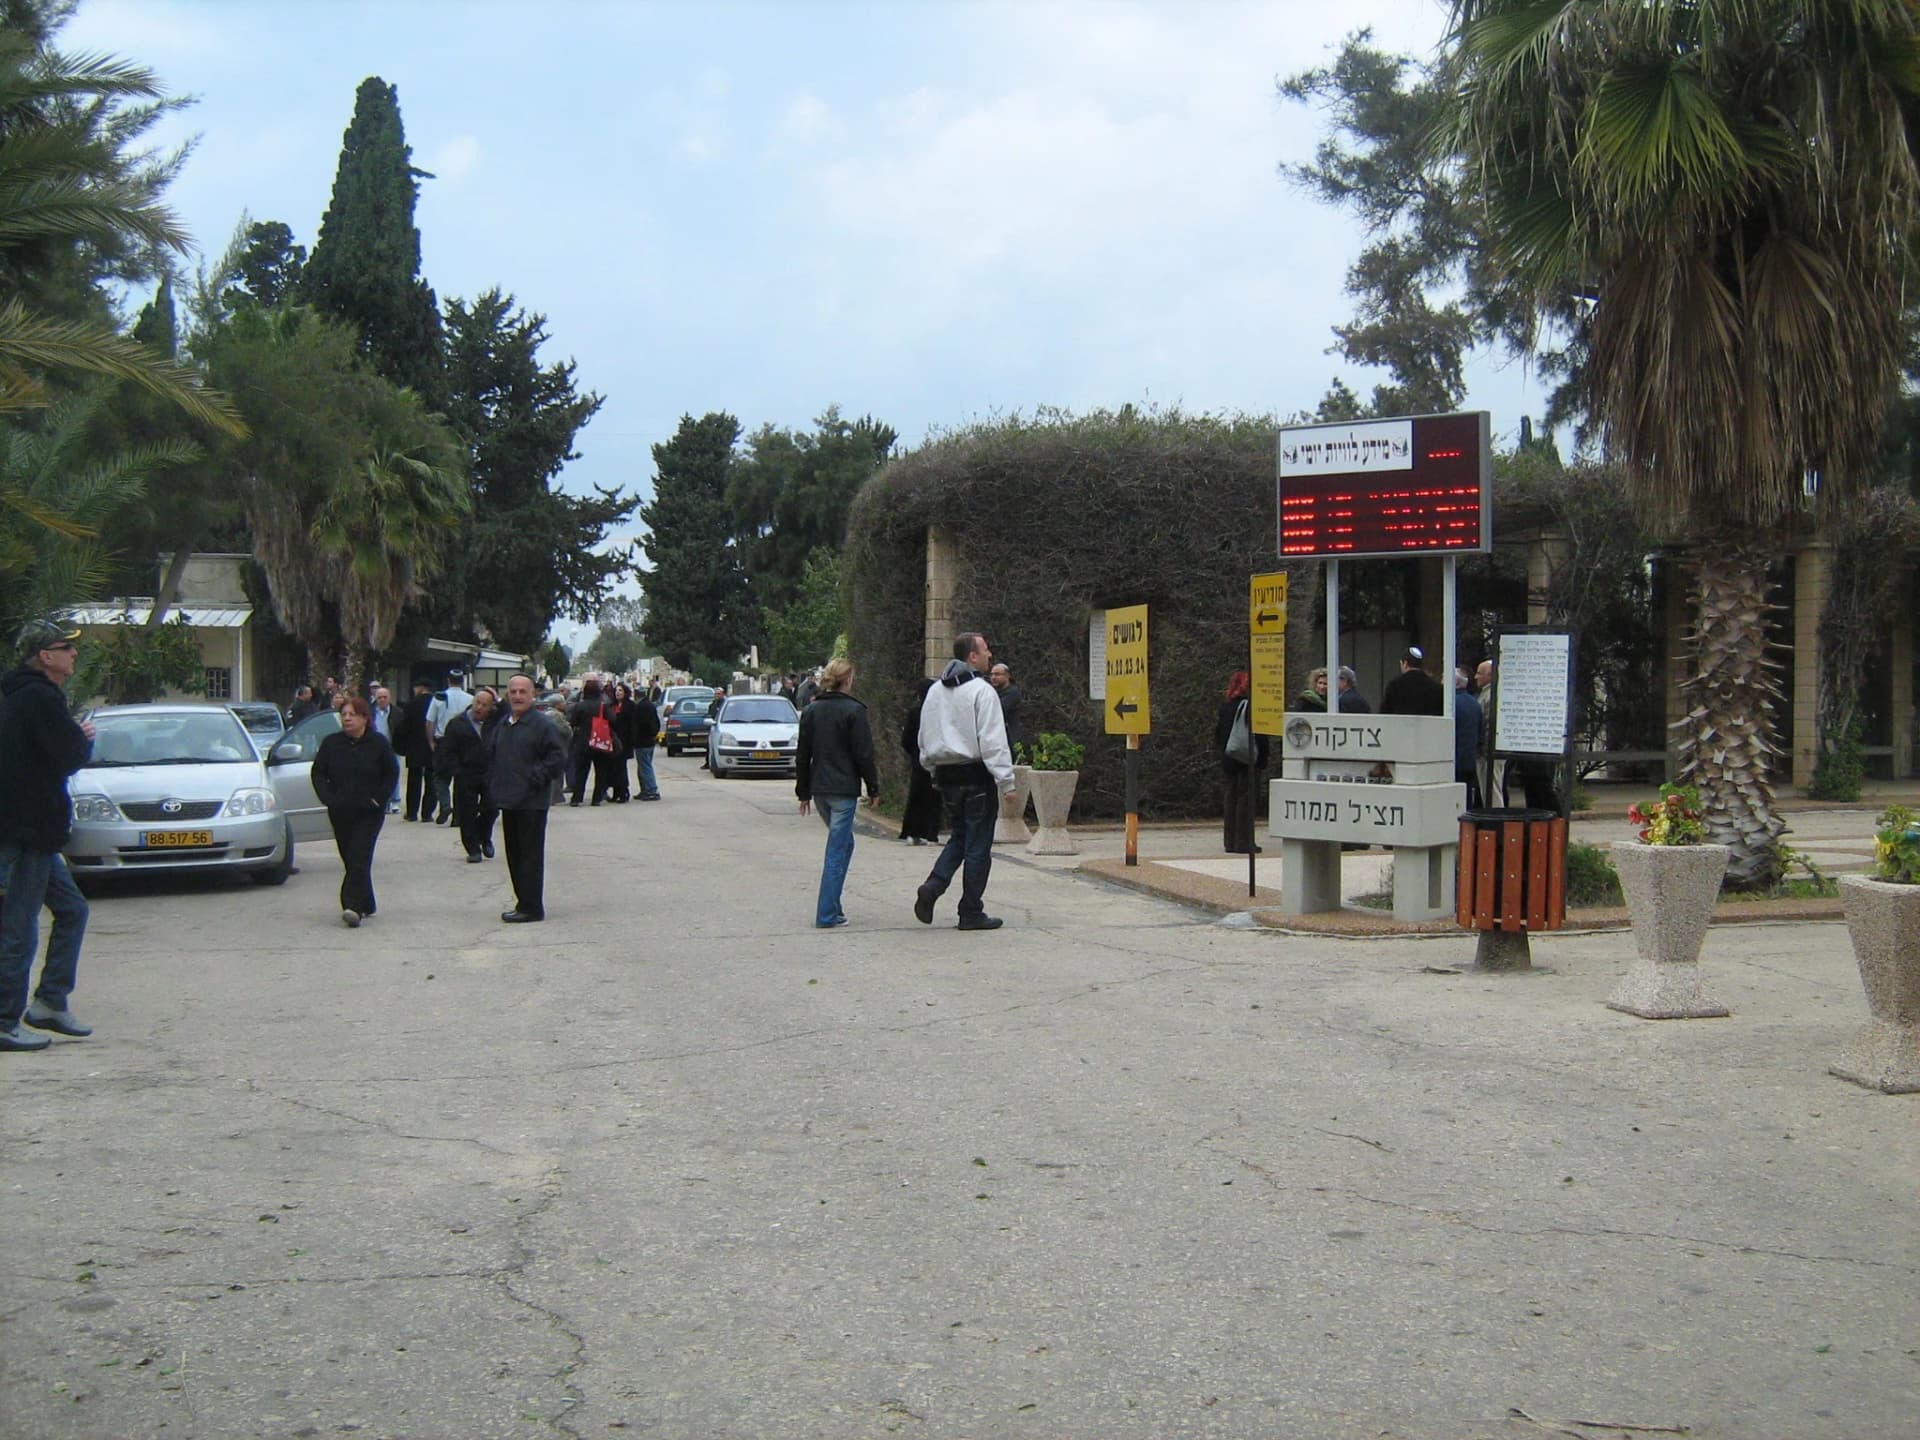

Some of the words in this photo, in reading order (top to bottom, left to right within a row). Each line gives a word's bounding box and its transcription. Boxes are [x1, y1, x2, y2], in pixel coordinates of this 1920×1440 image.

[1254, 585, 1284, 608] מודיעין
[1315, 727, 1382, 751] צדקה
[1285, 799, 1338, 823] ממות
[1348, 799, 1404, 827] תציל
